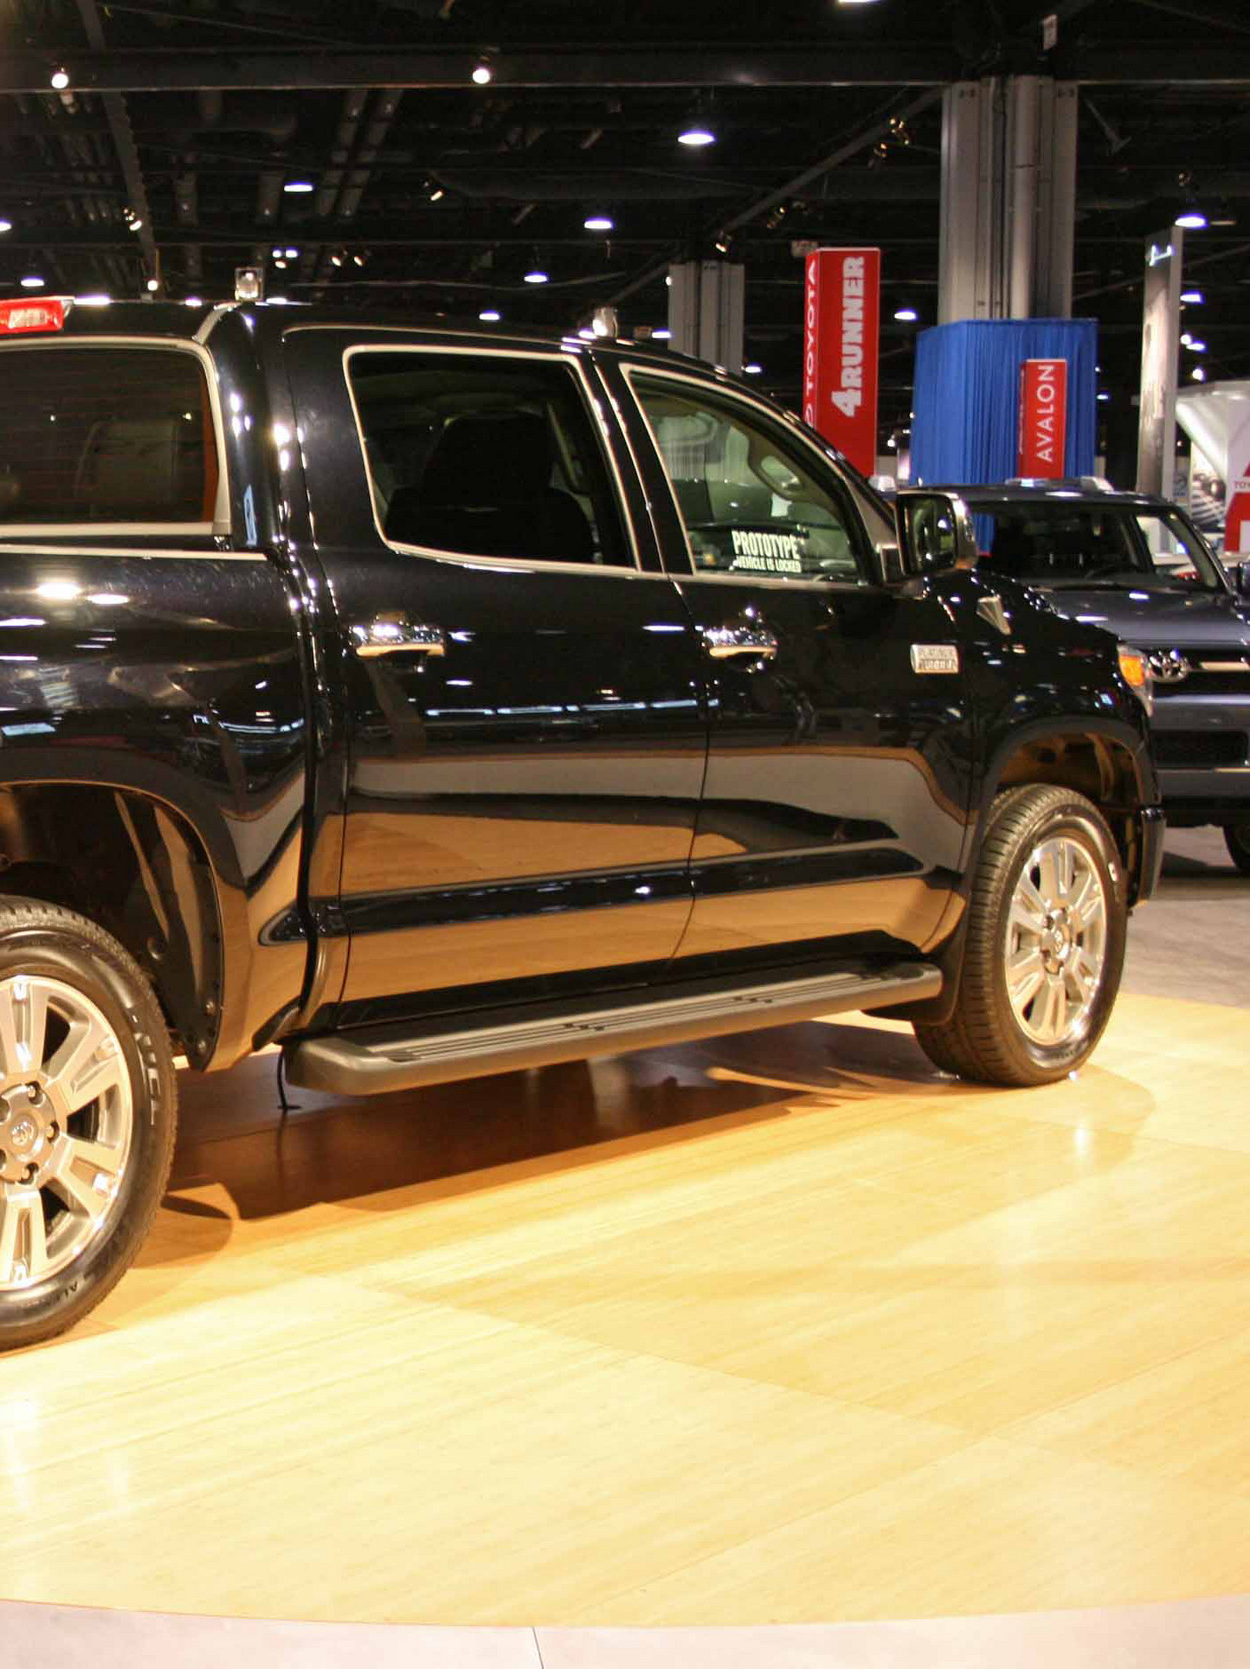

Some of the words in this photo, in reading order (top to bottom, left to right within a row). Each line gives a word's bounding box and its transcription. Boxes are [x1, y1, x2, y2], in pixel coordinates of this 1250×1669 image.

[806, 259, 816, 397] TOYOTA
[831, 256, 865, 418] 4RUNNER
[1036, 364, 1055, 462] AVALON
[731, 530, 801, 560] PROTOTYPE
[736, 555, 767, 571] VEHICLE
[766, 558, 775, 571] IS
[775, 559, 803, 574] LOCKED
